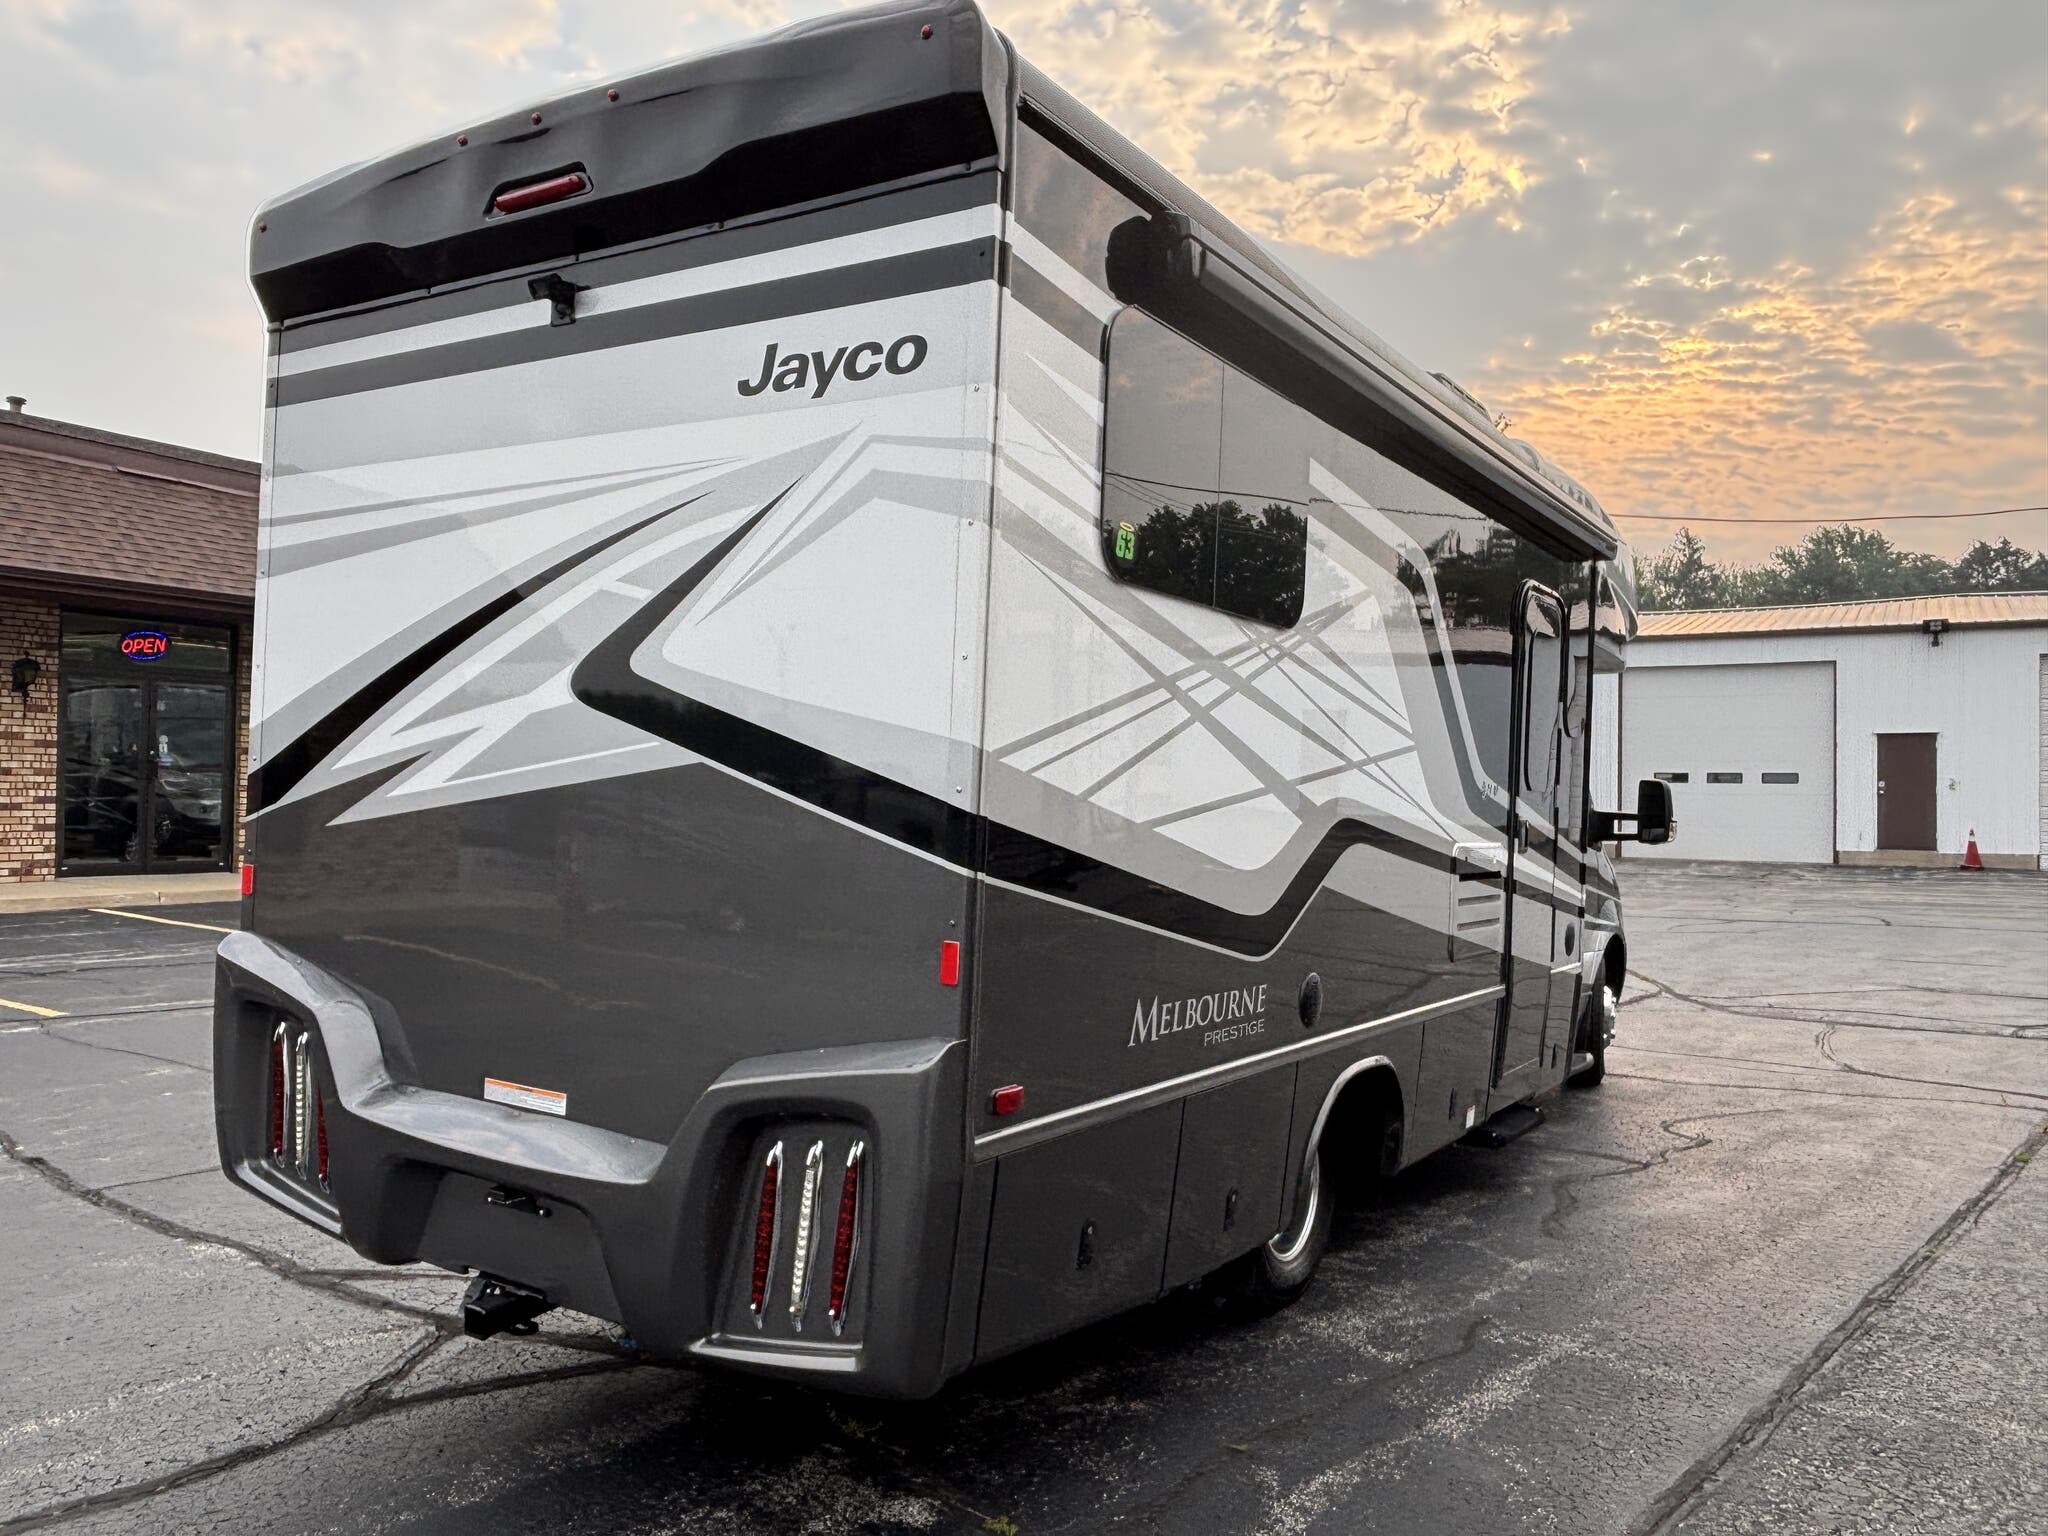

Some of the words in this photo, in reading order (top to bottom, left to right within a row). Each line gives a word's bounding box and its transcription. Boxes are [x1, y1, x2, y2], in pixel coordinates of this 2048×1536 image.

[737, 334, 928, 400] Jayco
[121, 638, 166, 653] OPEN
[1127, 984, 1268, 1048] MELBOURNE
[1203, 1018, 1265, 1047] PRESTIGE
